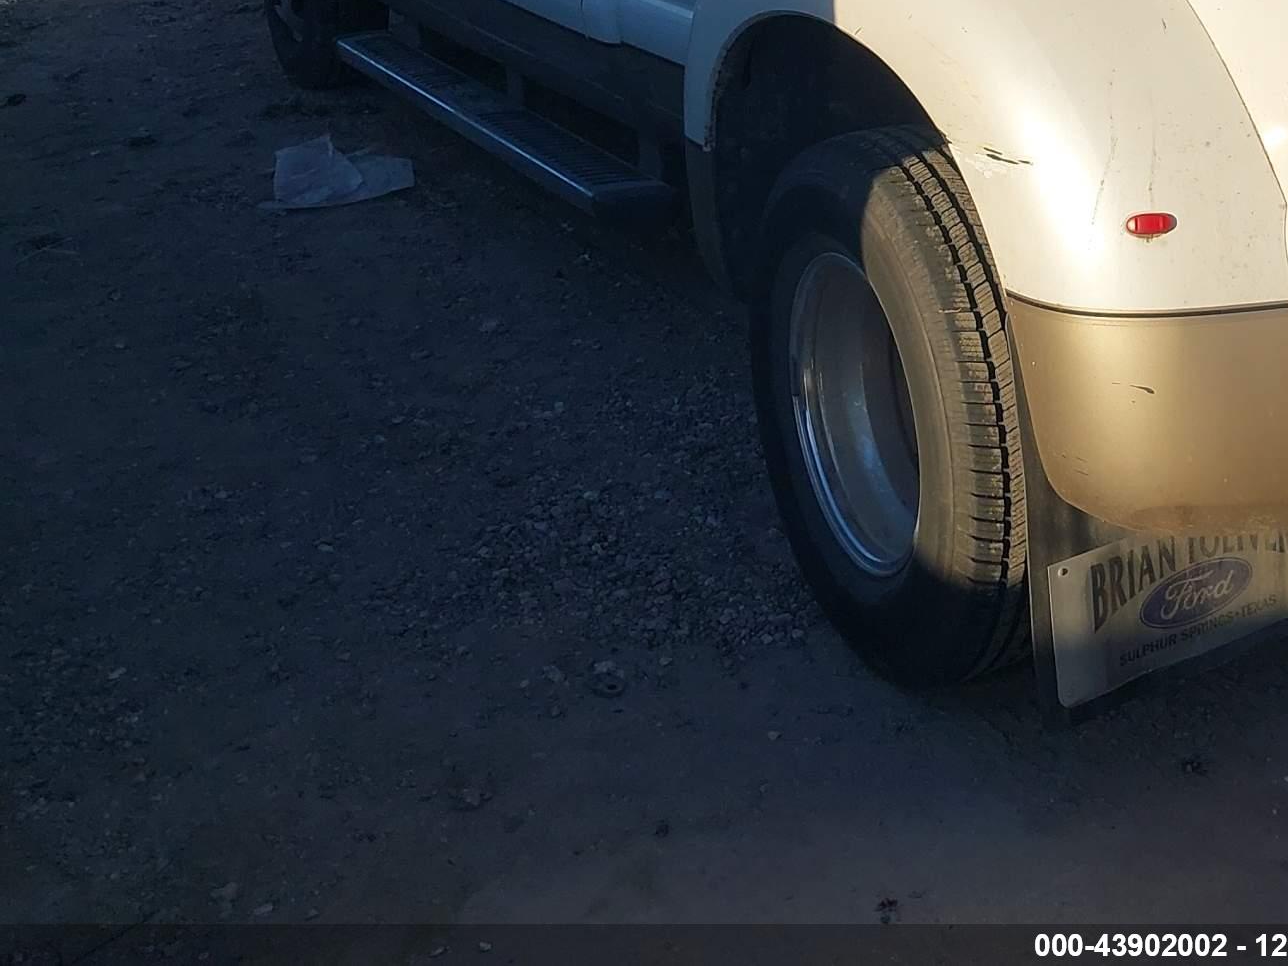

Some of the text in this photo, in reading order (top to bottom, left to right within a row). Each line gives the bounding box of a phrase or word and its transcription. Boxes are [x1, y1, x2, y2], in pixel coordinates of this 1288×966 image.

[1090, 535, 1177, 634] BRIAN
[1160, 569, 1235, 620] Ford
[1120, 633, 1178, 666] SULPHUR
